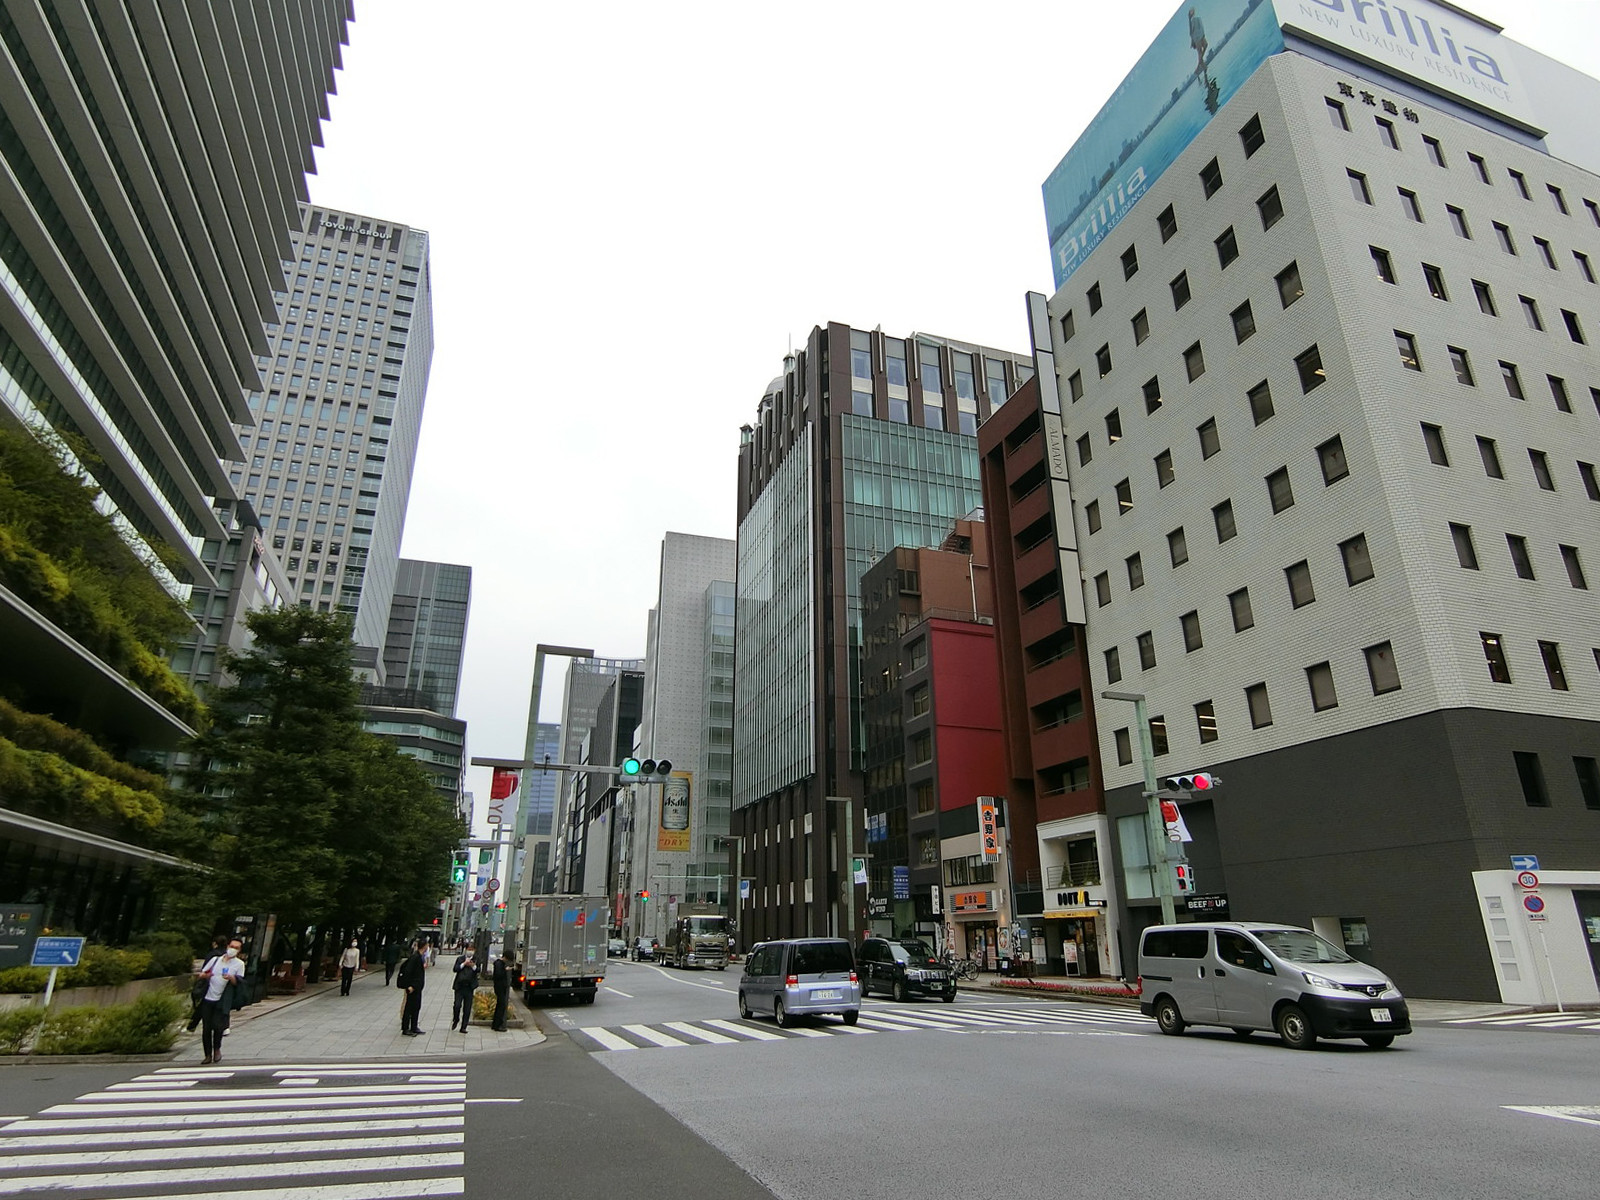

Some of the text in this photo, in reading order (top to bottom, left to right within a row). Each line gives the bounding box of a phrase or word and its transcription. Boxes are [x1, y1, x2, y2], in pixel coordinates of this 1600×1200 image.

[1299, 4, 1513, 104] NEW LUXURY RESIDENCE
[1309, 0, 1509, 85] rillia
[1337, 81, 1420, 124] 東京建物
[320, 220, 345, 231] TOYO
[359, 228, 392, 240] GROUP
[1058, 166, 1148, 270] Brillia
[1062, 183, 1149, 280] NEW LUXURY RESIDENCE
[664, 796, 688, 807] Asahi
[983, 810, 995, 849] 吉野家
[1522, 875, 1535, 885] 30
[1188, 899, 1227, 909] BEEF UP
